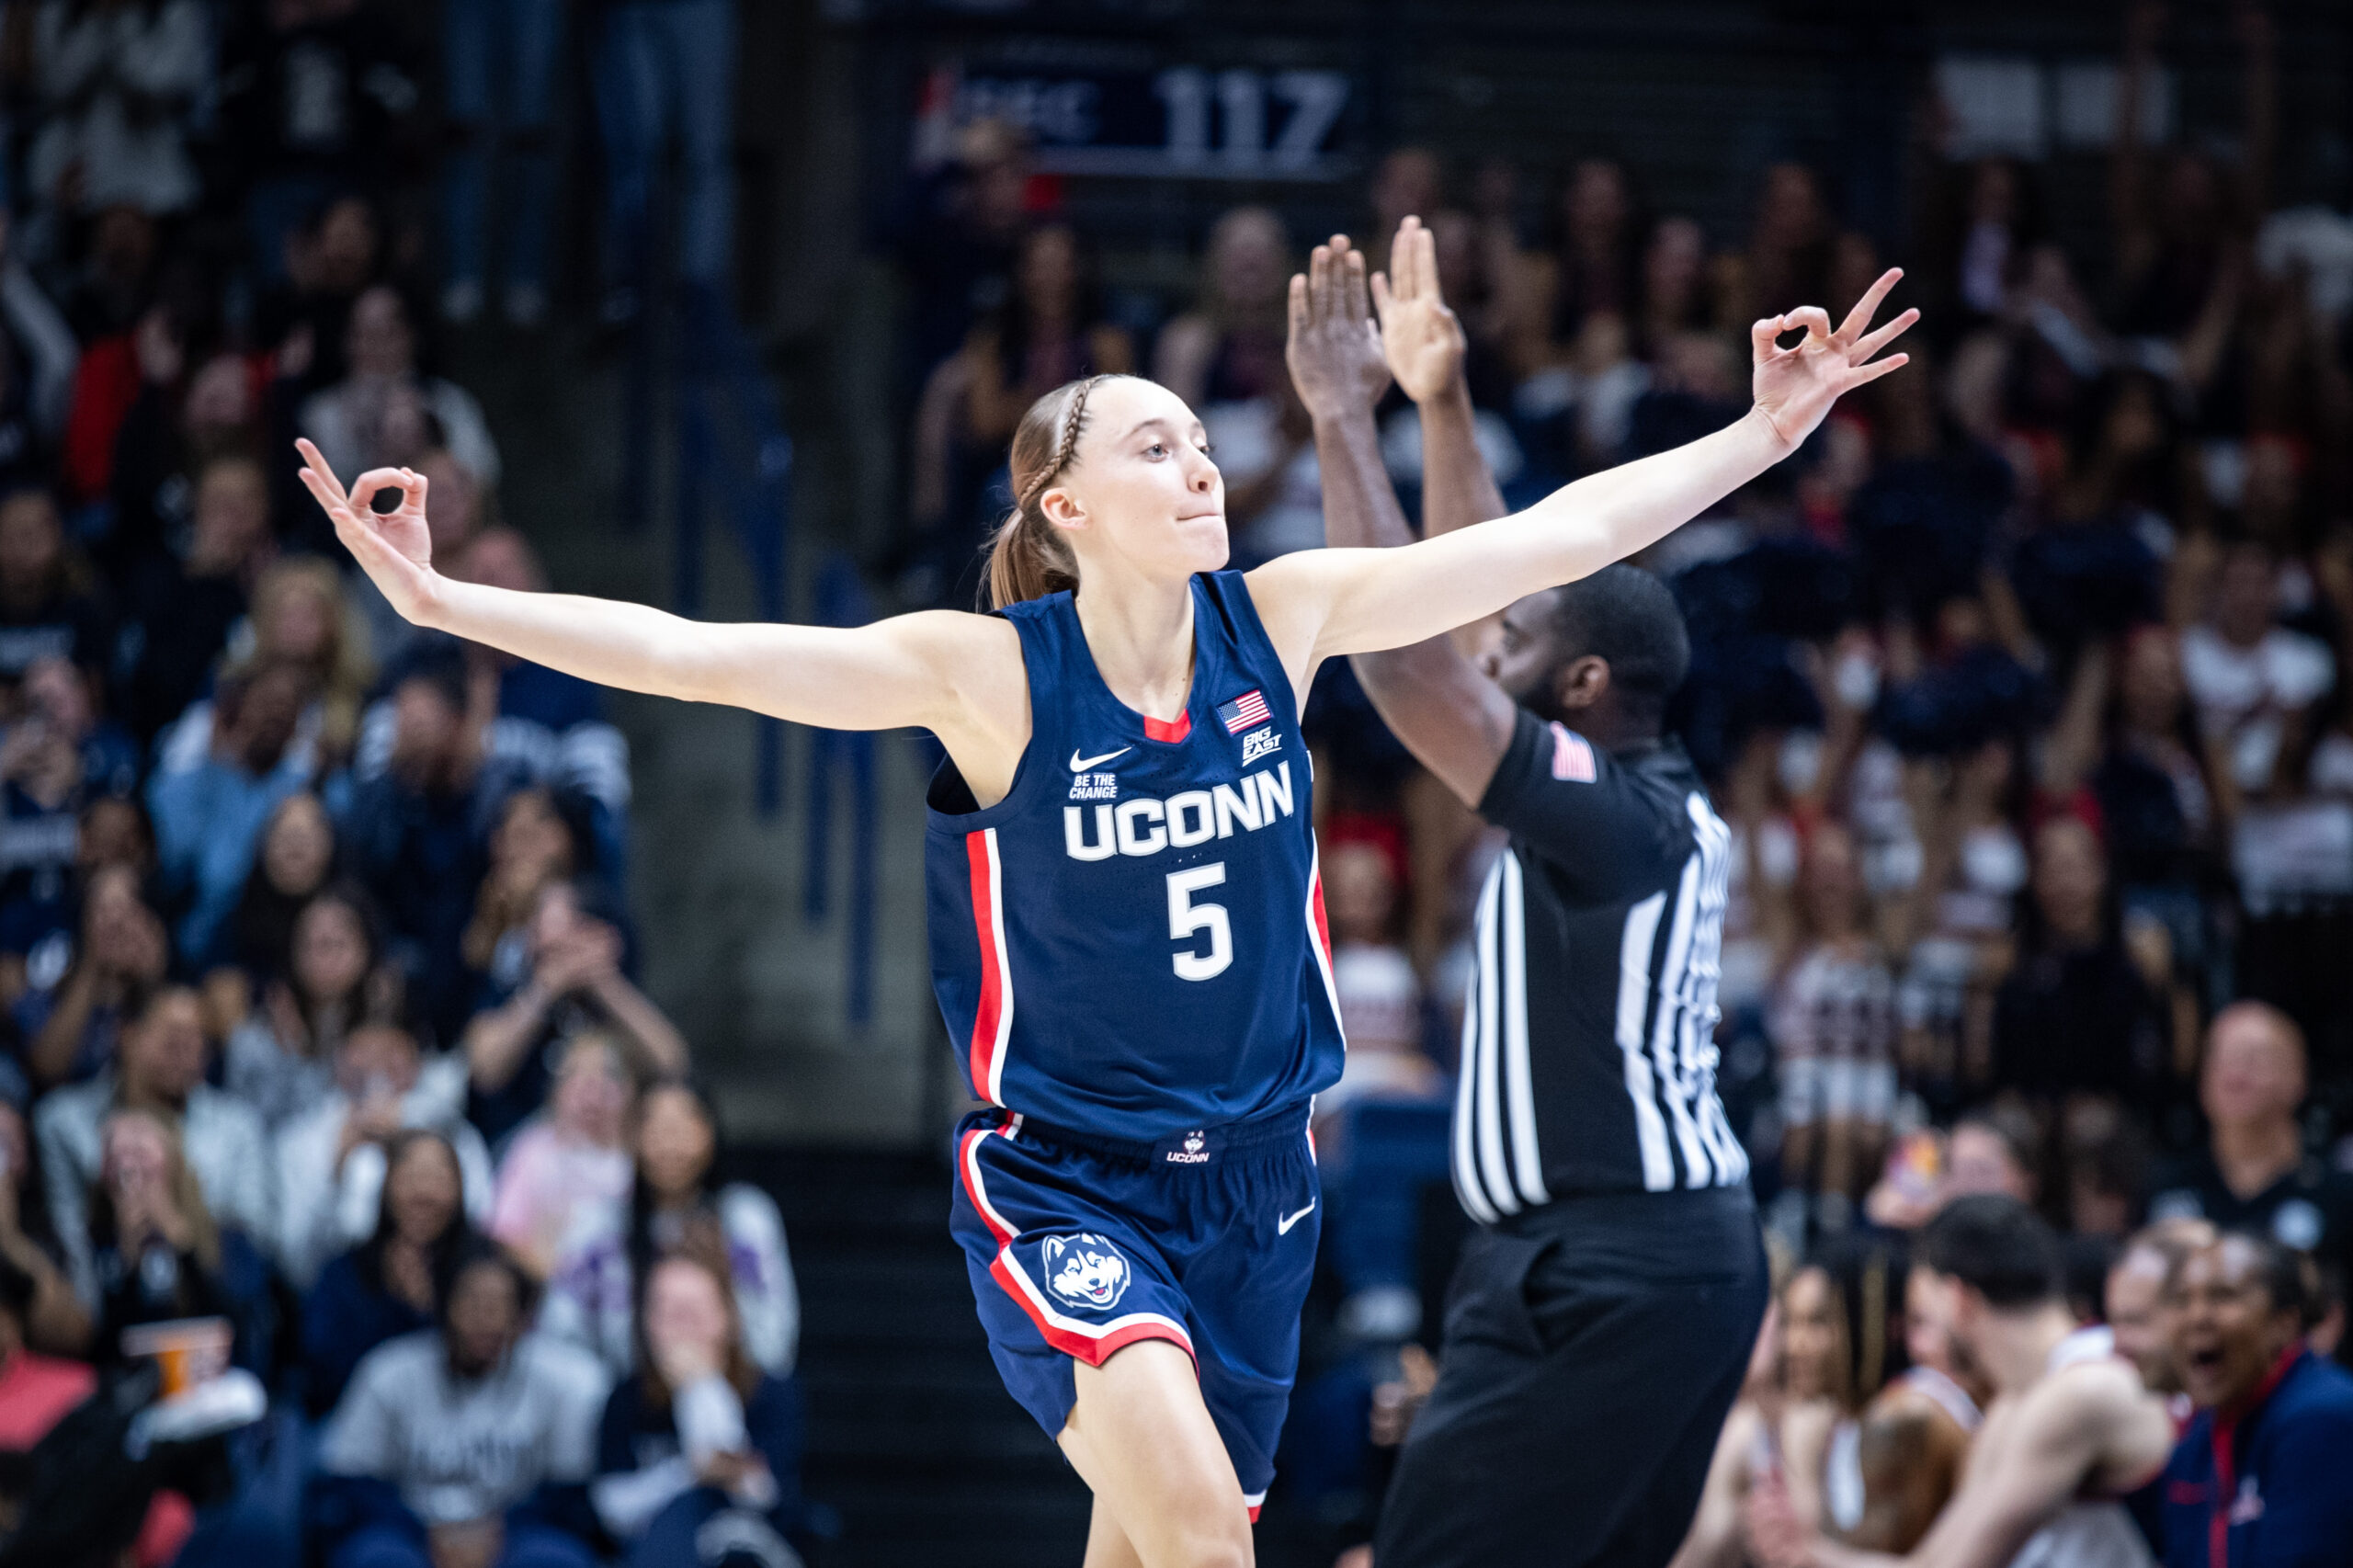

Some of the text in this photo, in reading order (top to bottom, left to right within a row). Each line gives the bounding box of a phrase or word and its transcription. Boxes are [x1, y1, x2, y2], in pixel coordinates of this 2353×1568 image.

[1156, 67, 1349, 168] 117
[1243, 726, 1271, 749] BIG
[1243, 733, 1282, 760] EAST
[1074, 772, 1116, 787] BE THE
[1069, 786, 1118, 800] CHANGE
[1063, 760, 1294, 861] UCONN
[1165, 861, 1233, 982] 5
[1166, 1152, 1210, 1164] UCONN
